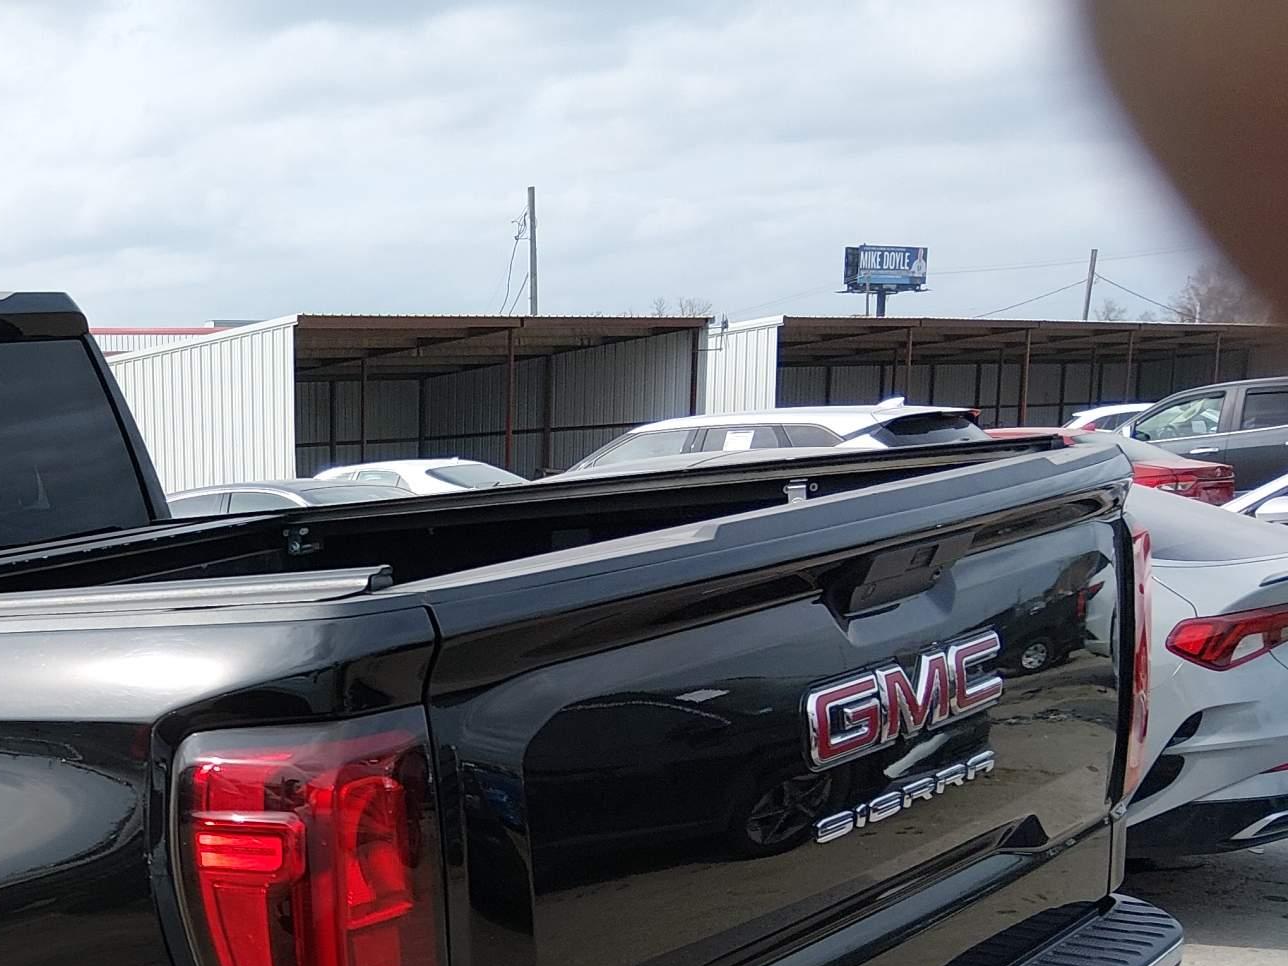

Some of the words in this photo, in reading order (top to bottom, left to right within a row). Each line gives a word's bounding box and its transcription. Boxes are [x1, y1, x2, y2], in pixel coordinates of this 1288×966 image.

[859, 250, 882, 269] MIKE
[883, 251, 910, 270] DOYLE
[805, 629, 1004, 768] GMC
[815, 749, 995, 844] SIERRA
